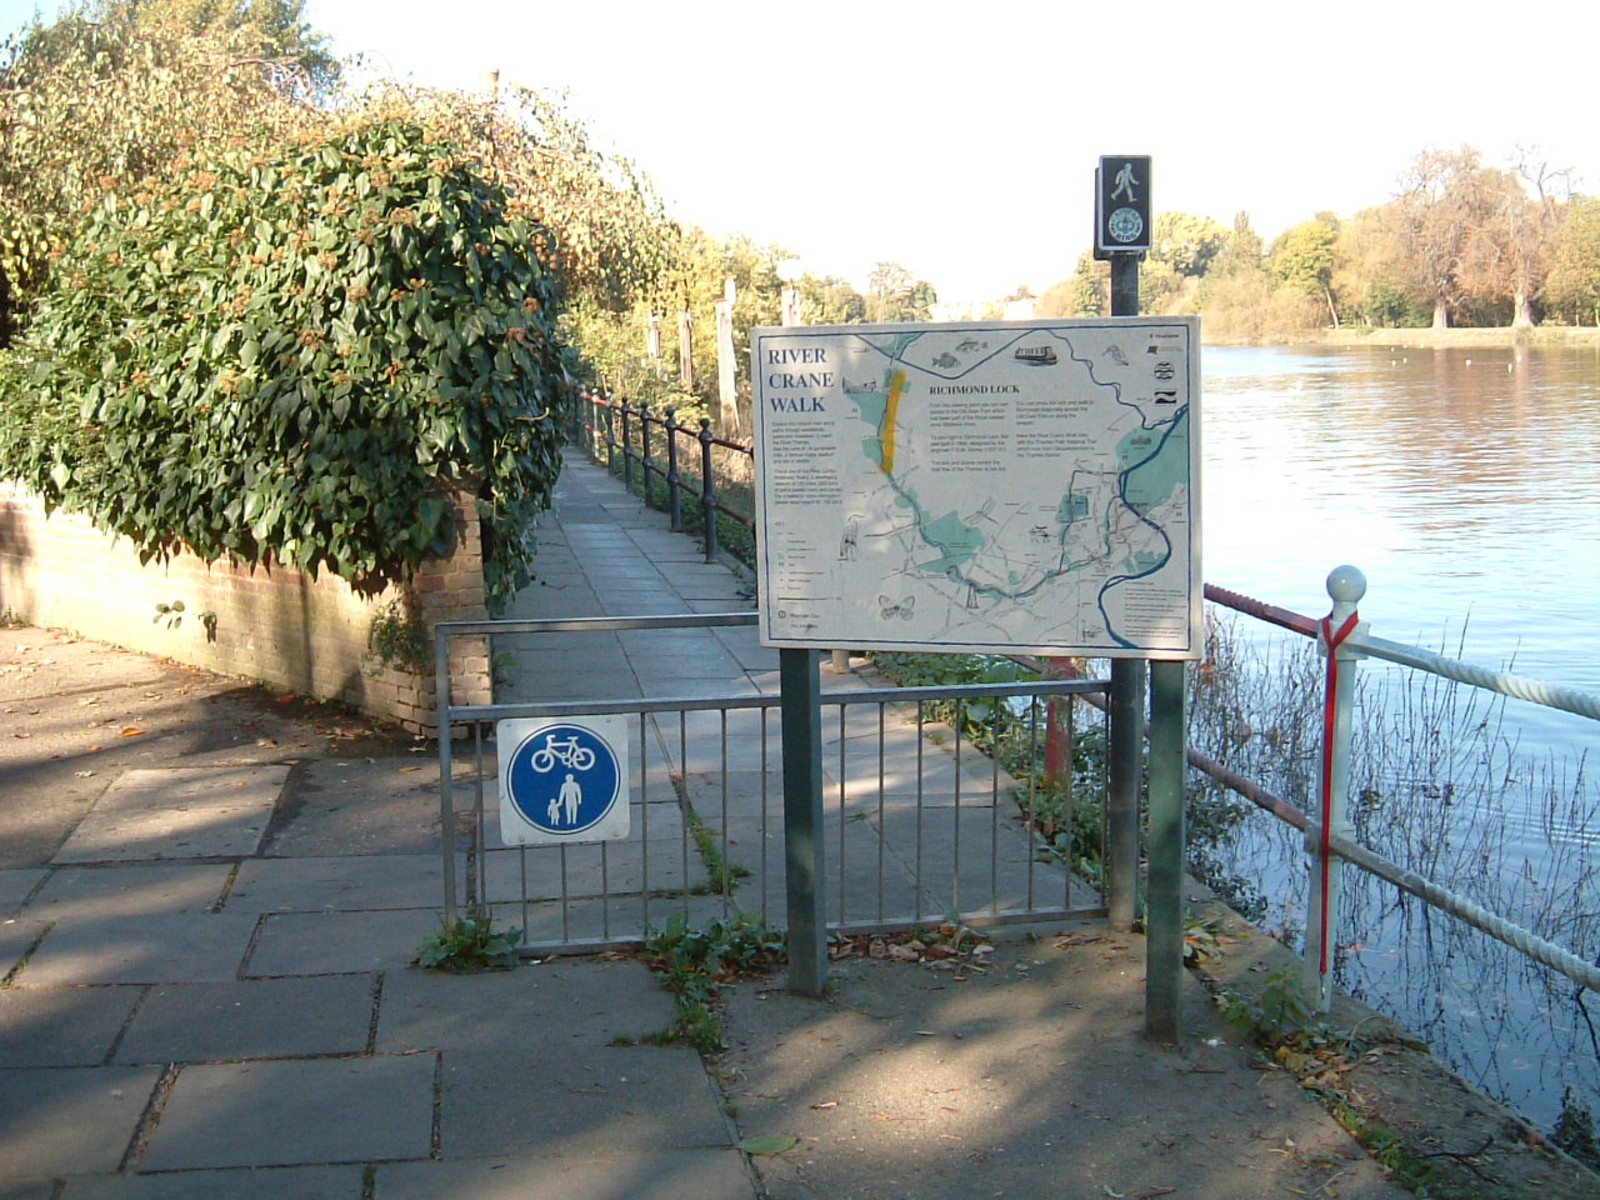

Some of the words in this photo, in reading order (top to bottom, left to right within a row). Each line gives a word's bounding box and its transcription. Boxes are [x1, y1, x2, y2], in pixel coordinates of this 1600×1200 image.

[768, 348, 827, 364] RIVER
[768, 372, 835, 389] CRANE
[929, 384, 989, 396] RICHMOND
[990, 384, 1020, 395] LOCK
[770, 396, 827, 413] WALK
